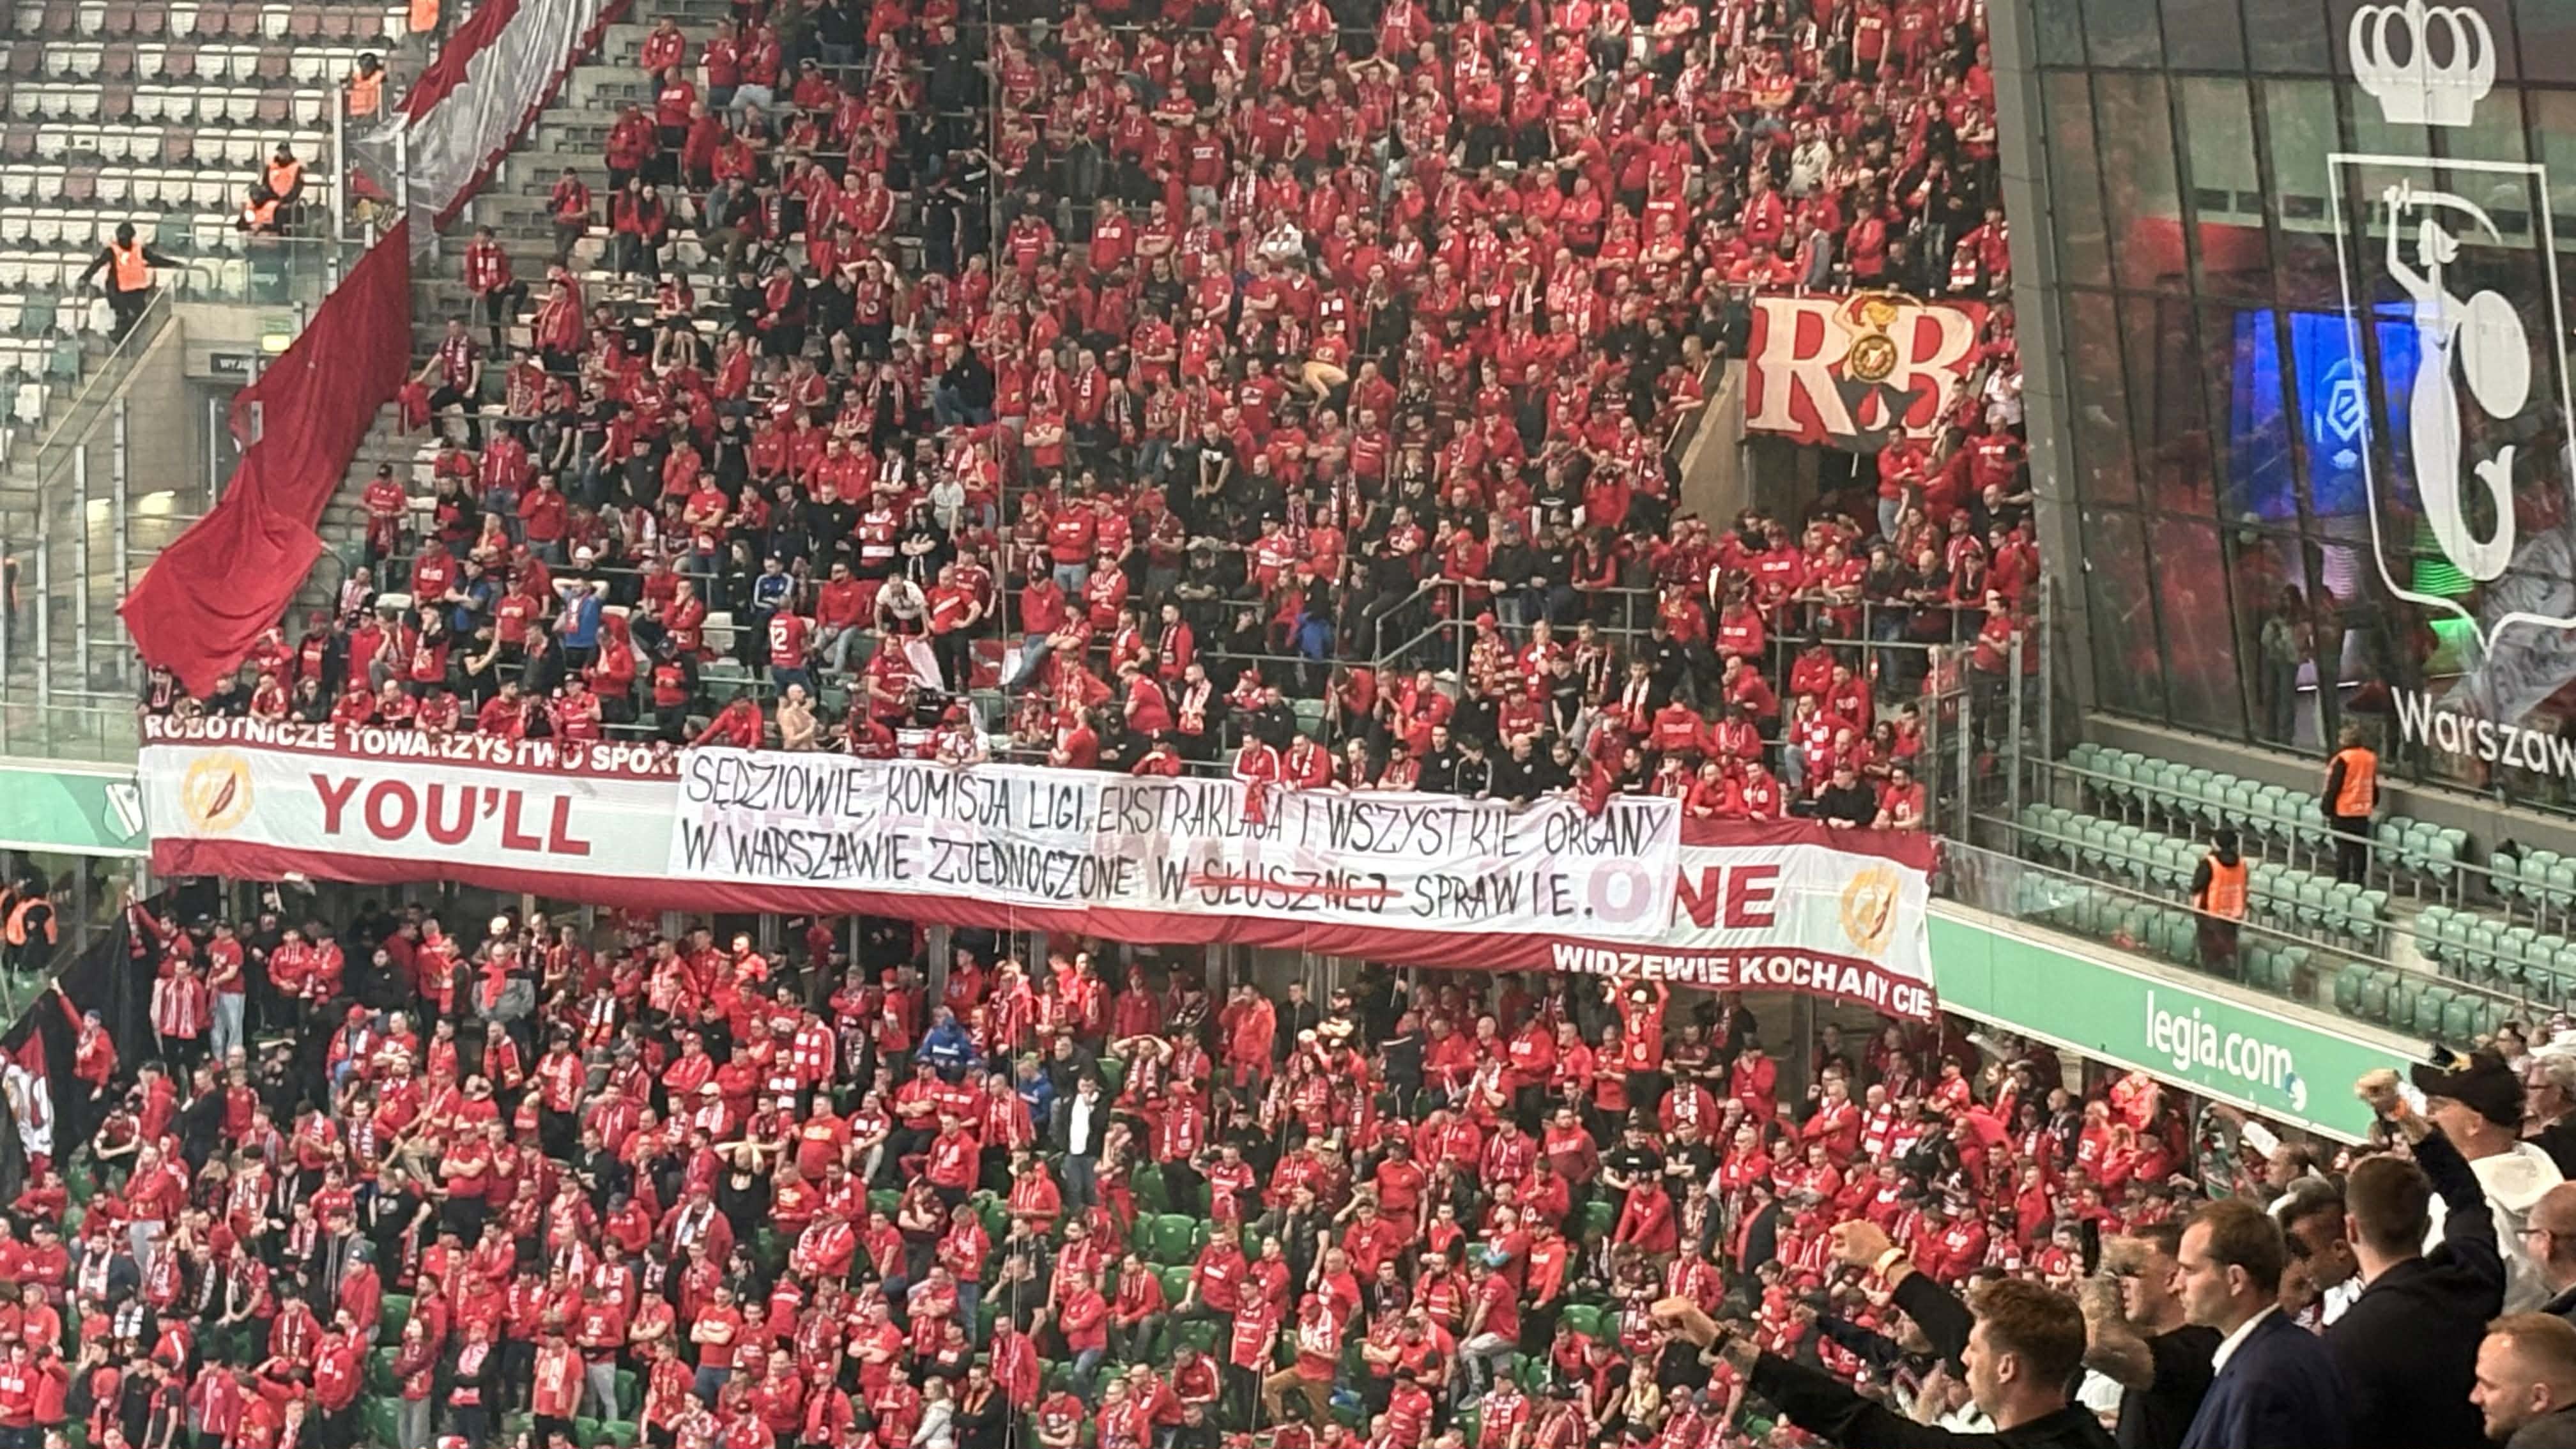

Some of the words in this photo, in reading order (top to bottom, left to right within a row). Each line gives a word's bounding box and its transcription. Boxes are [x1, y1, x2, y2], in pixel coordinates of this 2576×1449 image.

[307, 772, 591, 857] YOU'LL
[885, 765, 1011, 829] KOMISJA
[1328, 799, 1522, 857] WSZYSTKIE
[1545, 804, 1671, 857] ORGANY
[682, 818, 717, 871] W
[727, 825, 911, 880] WARSZAWIE
[928, 836, 1137, 900] ZJEDNOCZONE
[1157, 857, 1188, 903] W
[1552, 943, 1730, 984] WIDZEWIE
[2146, 989, 2293, 1090] legia.com
